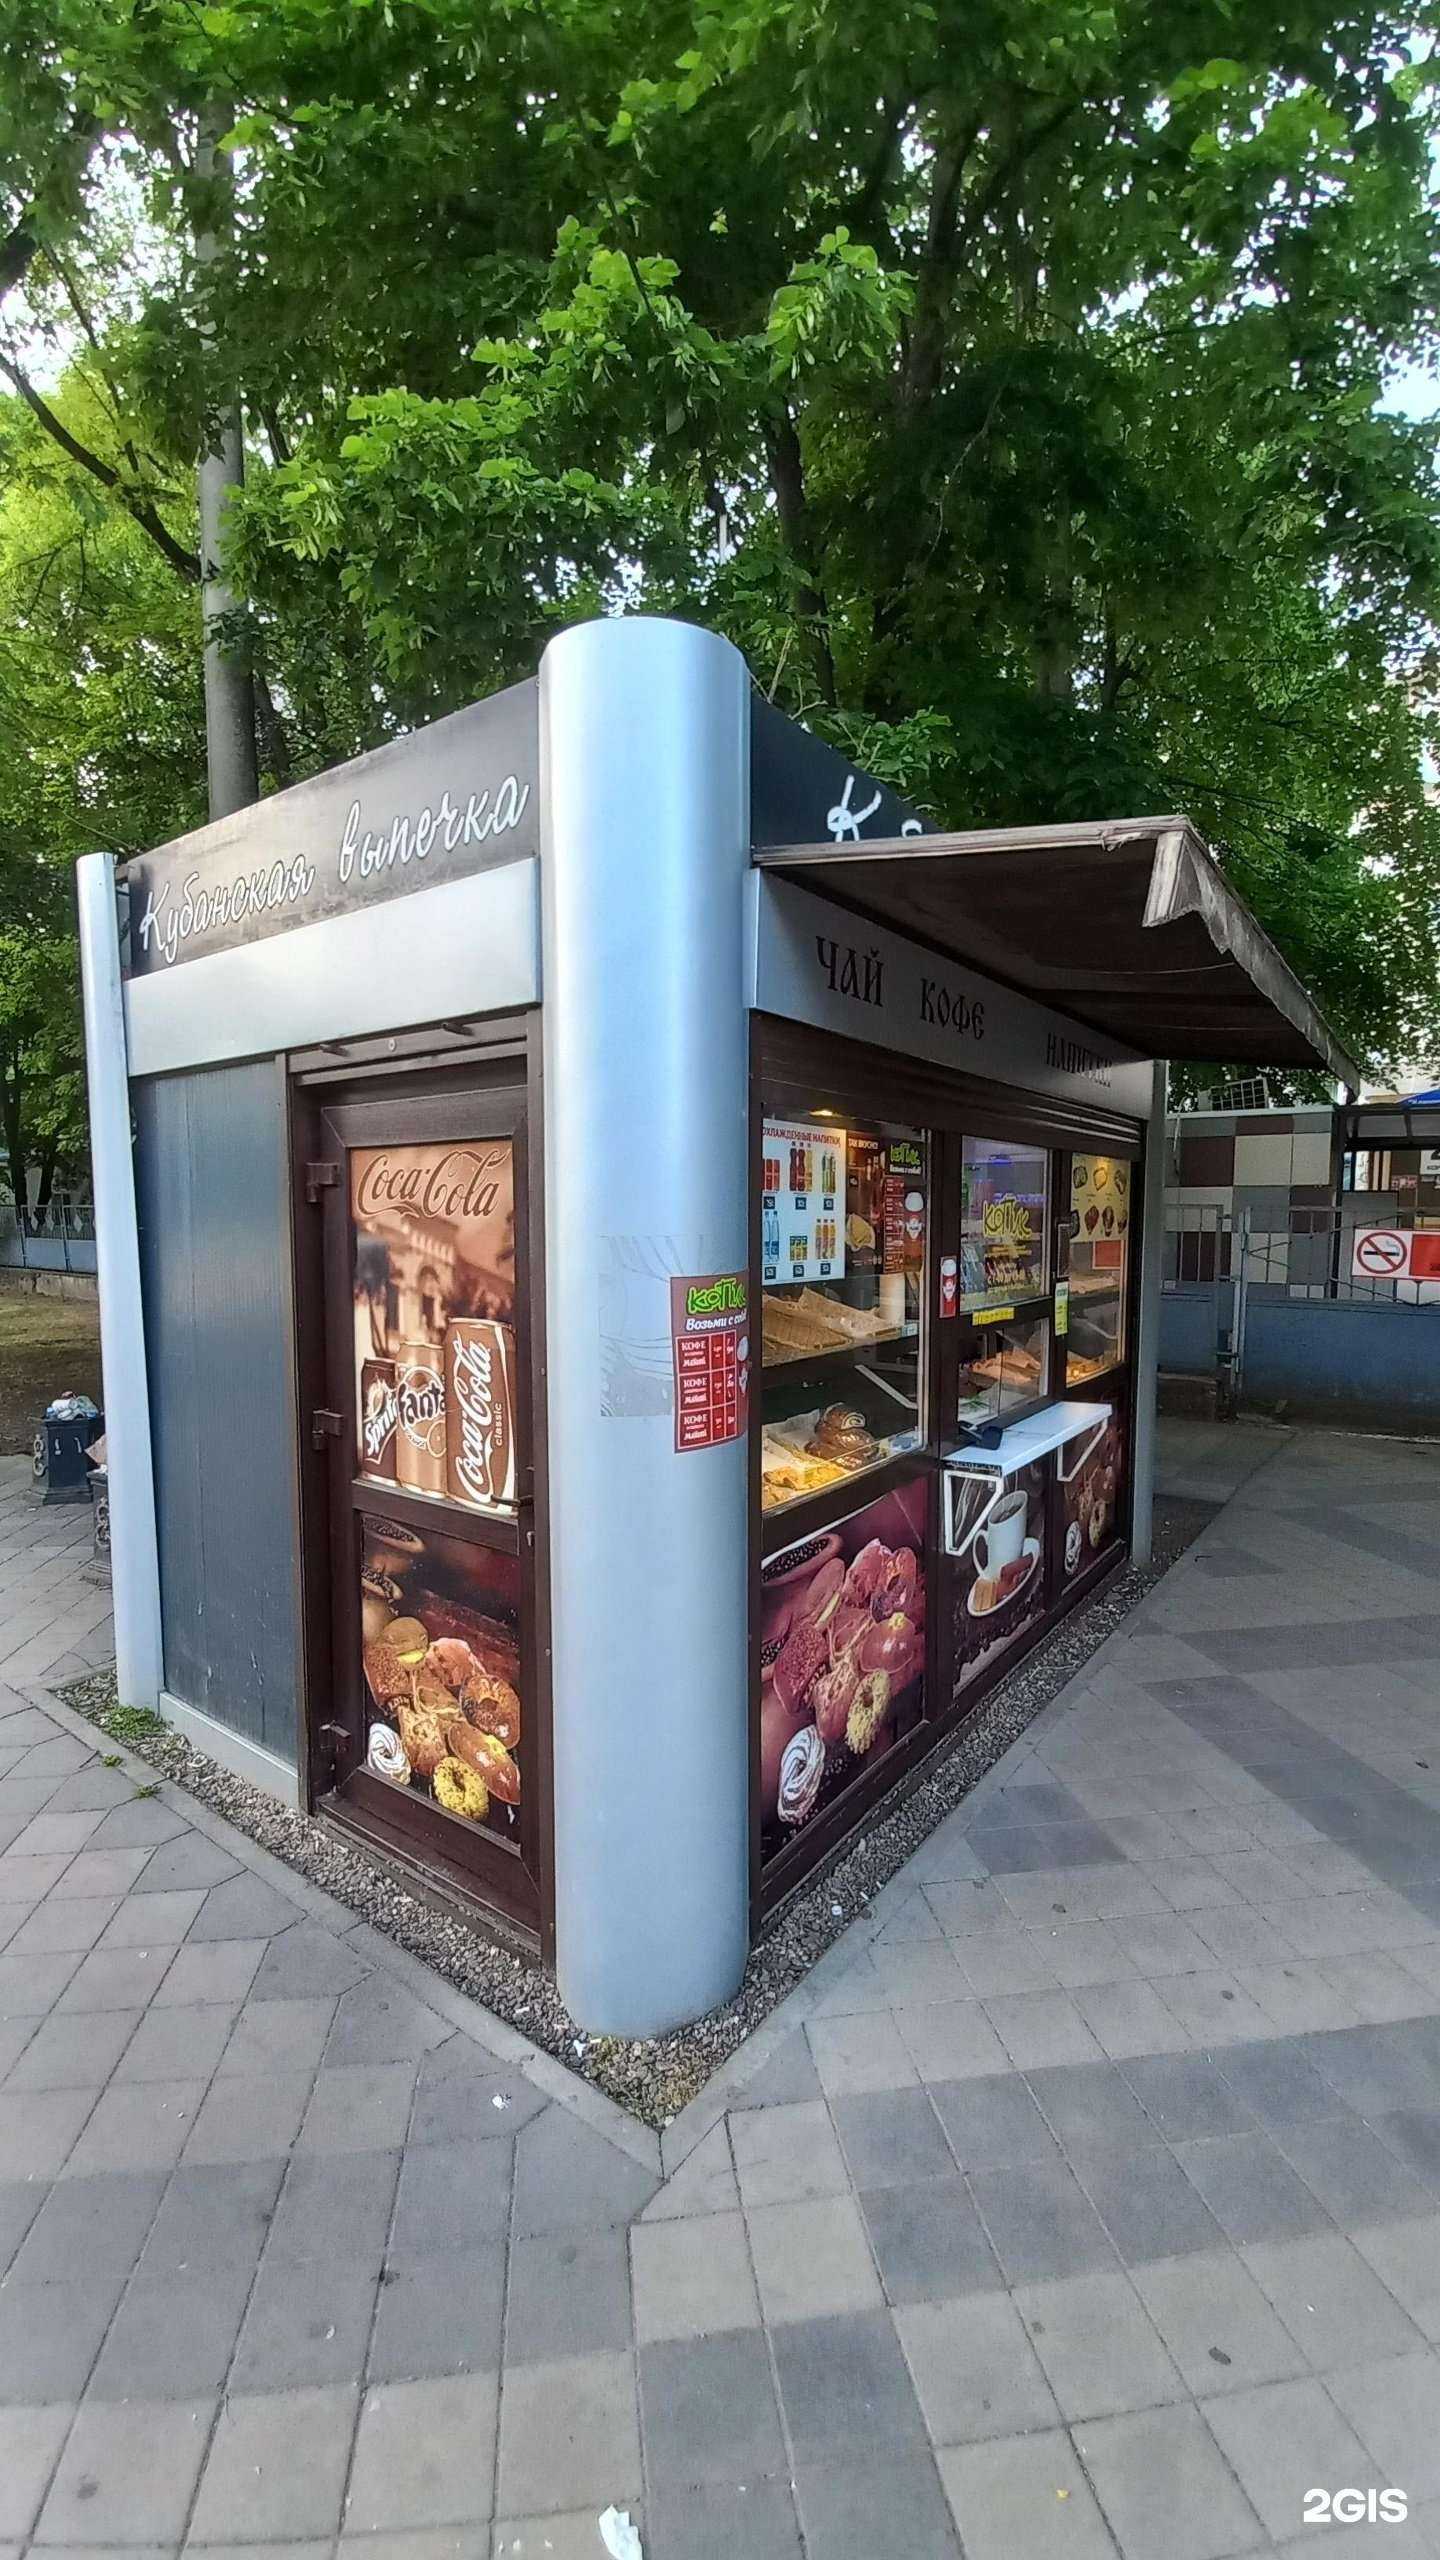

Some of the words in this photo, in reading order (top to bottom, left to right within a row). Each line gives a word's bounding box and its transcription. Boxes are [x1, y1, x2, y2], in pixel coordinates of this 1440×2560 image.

[138, 854, 316, 964] Кубанская
[815, 935, 884, 1007] ЧАЙ
[919, 976, 986, 1040] КОФЕ
[357, 1150, 511, 1218] Coca-Cola
[686, 1317, 727, 1331] Возьми
[681, 1340, 706, 1351] КОФЕ
[683, 1377, 707, 1388] КОФЕ
[492, 1402, 504, 1447] classic
[683, 1413, 709, 1425] КОФЕ
